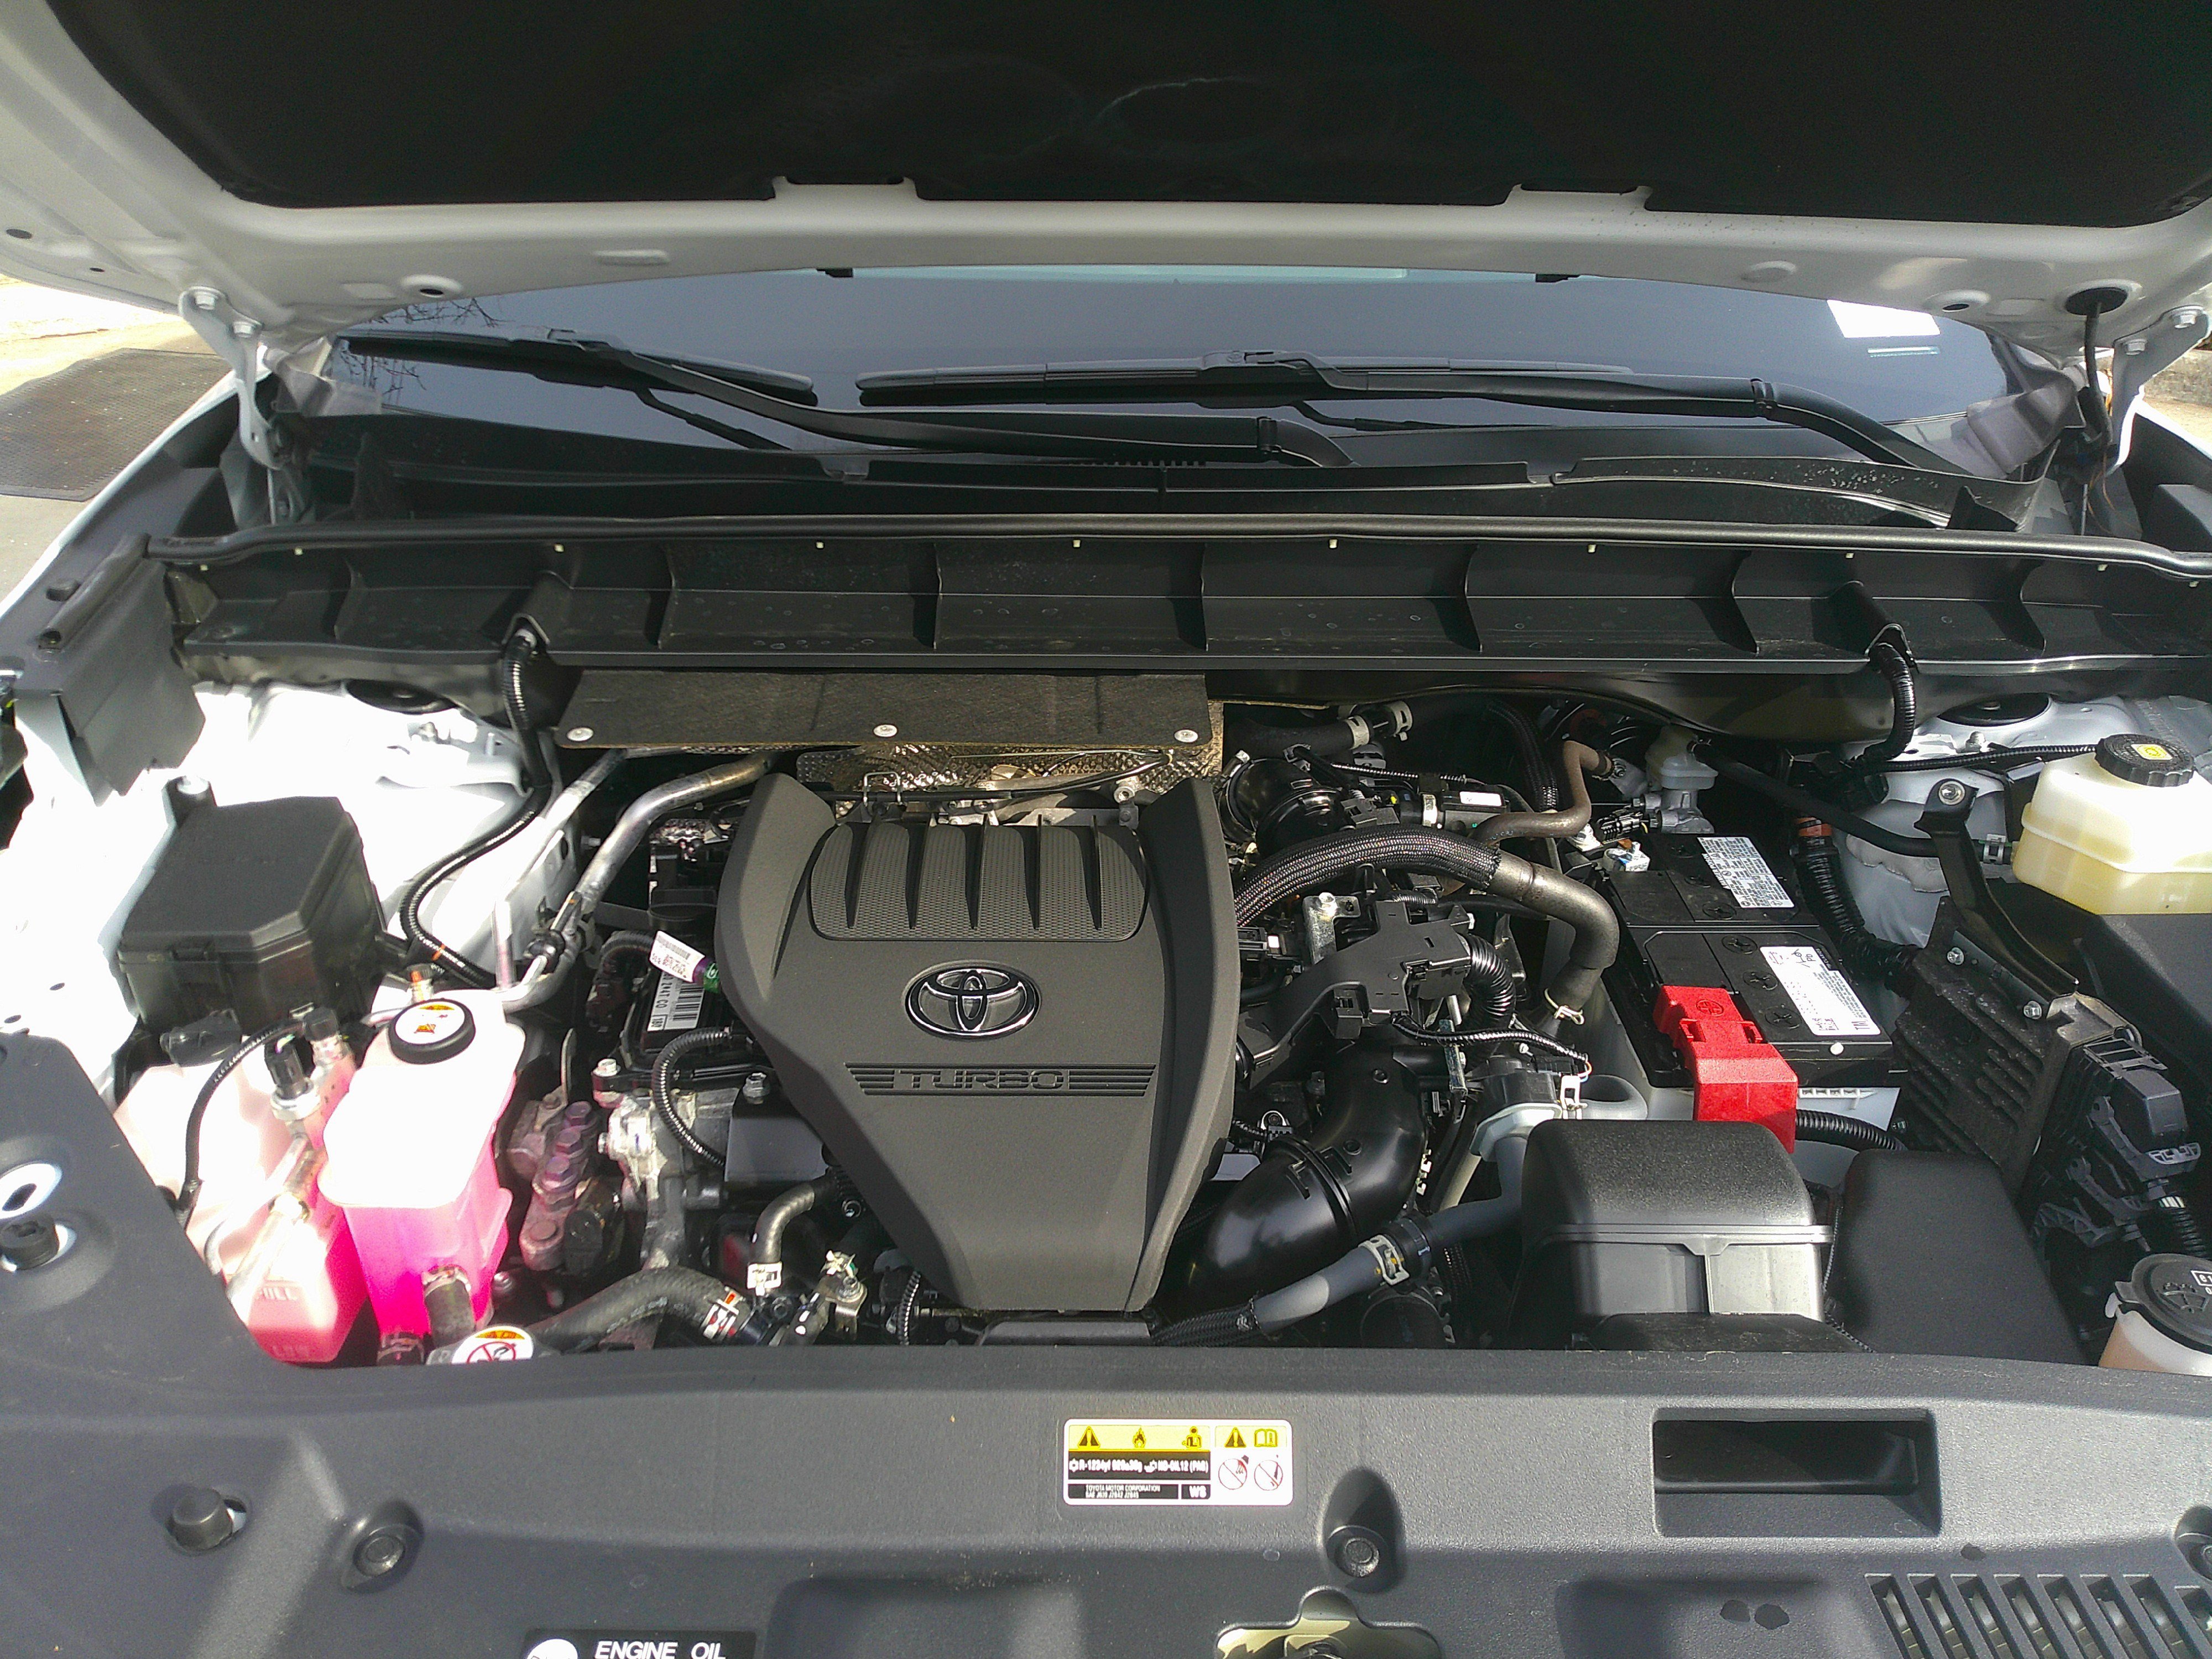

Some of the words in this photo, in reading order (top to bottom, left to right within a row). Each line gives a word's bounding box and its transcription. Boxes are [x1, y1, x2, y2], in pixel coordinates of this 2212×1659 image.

[899, 1070, 1065, 1090] TURBO
[594, 1641, 678, 1659] ENGINE
[691, 1642, 726, 1659] OIL
